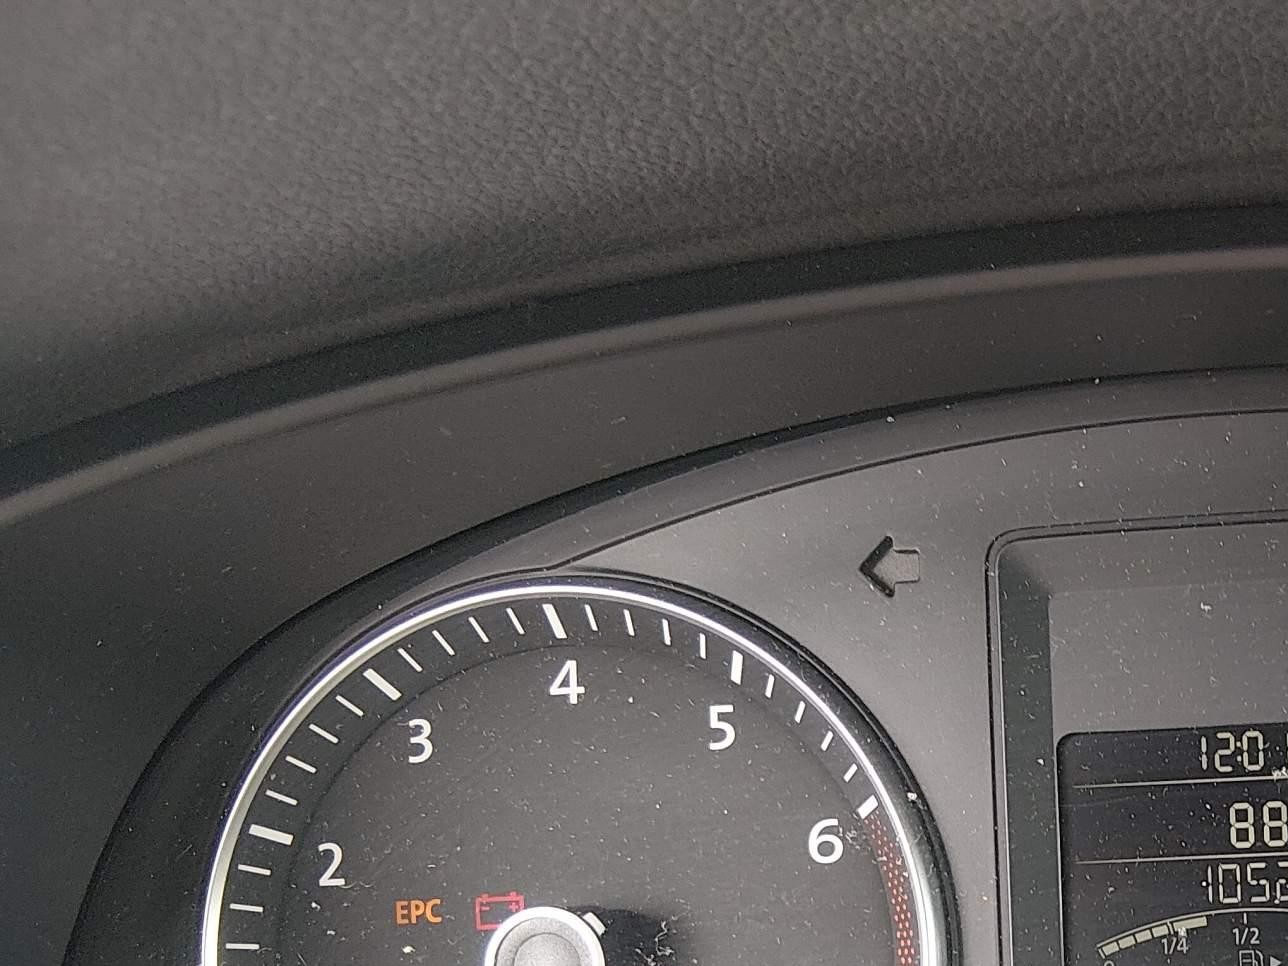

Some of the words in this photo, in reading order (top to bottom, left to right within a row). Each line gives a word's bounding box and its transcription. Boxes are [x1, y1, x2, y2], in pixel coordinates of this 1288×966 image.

[549, 660, 585, 704] 4
[407, 718, 433, 763] 3
[709, 705, 736, 750] 5
[808, 818, 845, 864] 6
[1229, 800, 1288, 849] 88
[318, 842, 345, 887] 2
[395, 900, 442, 925] EPC
[1161, 937, 1188, 955] 1/4
[1232, 927, 1260, 945] 1/2
